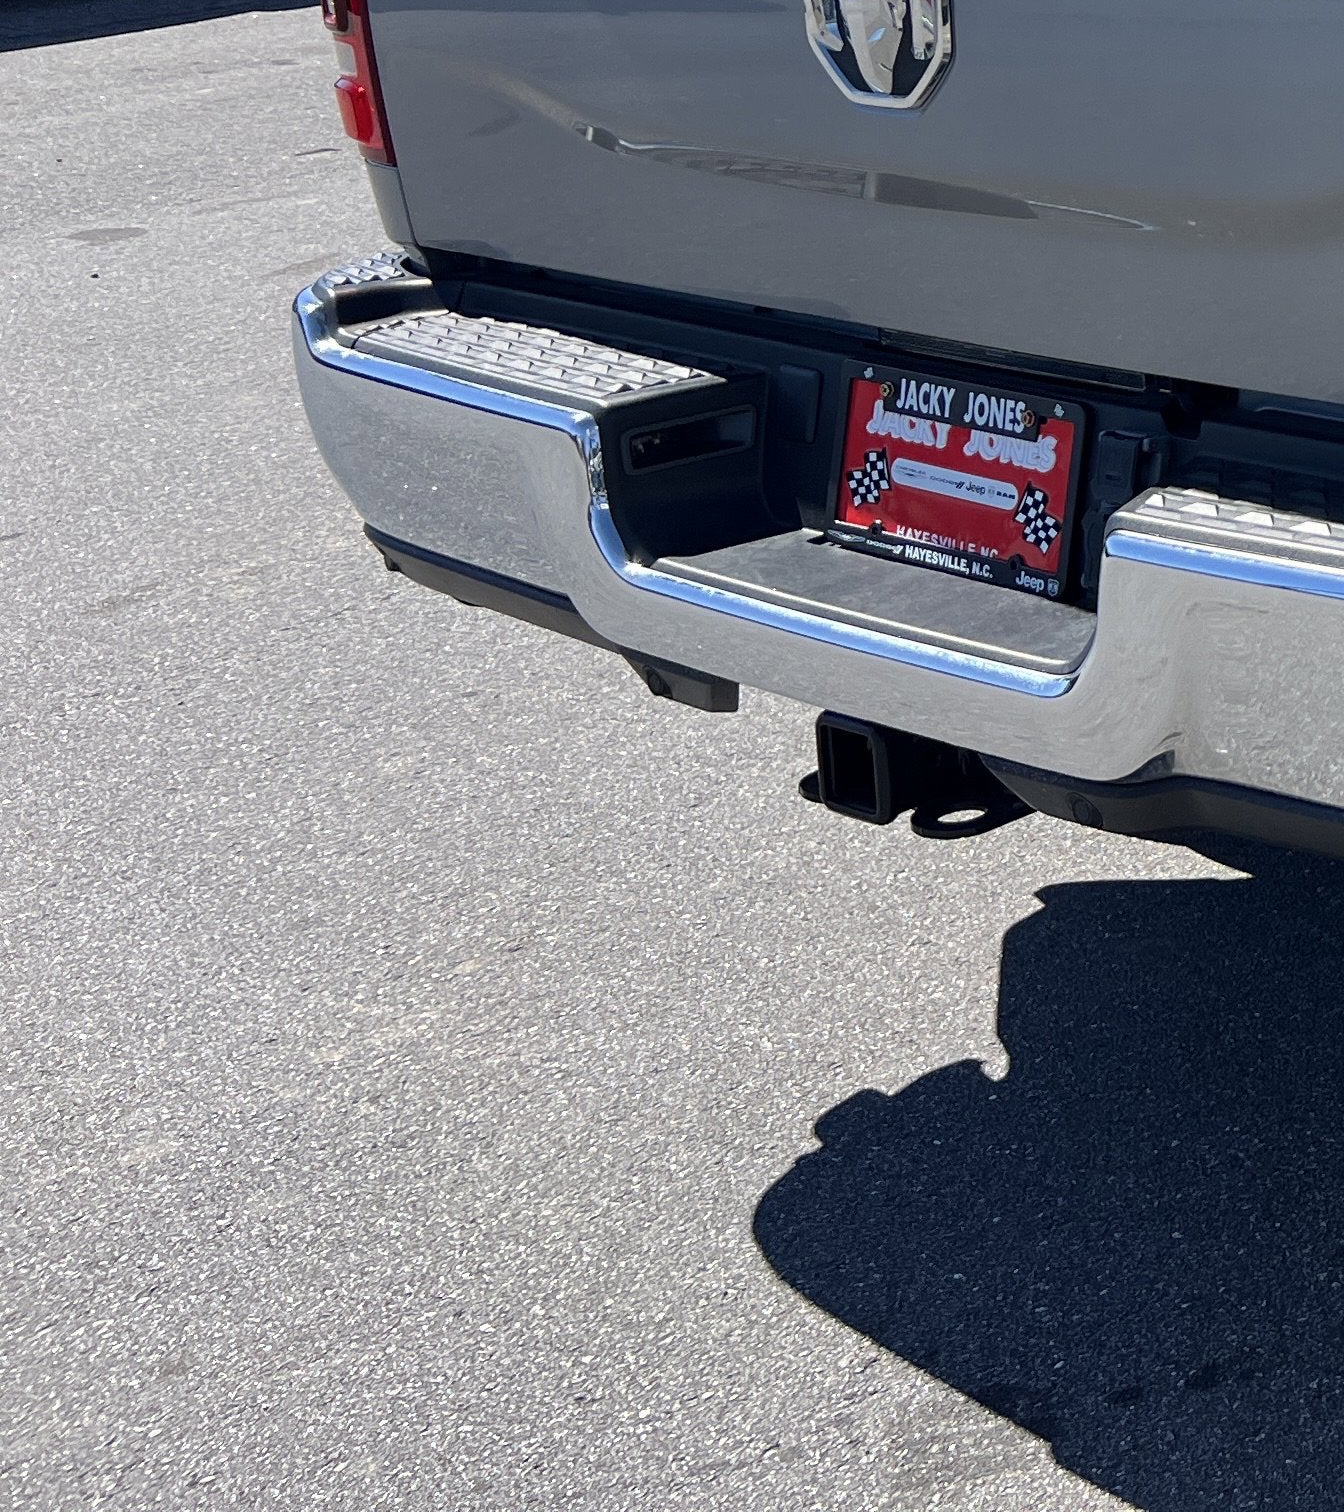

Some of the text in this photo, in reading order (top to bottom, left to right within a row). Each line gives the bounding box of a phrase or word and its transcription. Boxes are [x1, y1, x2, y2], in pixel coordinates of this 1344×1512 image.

[896, 378, 1026, 434] JACKY JONES
[905, 545, 970, 576] HAYESVILLE,
[972, 561, 994, 578] N.C.
[1015, 571, 1044, 592] Jeep
